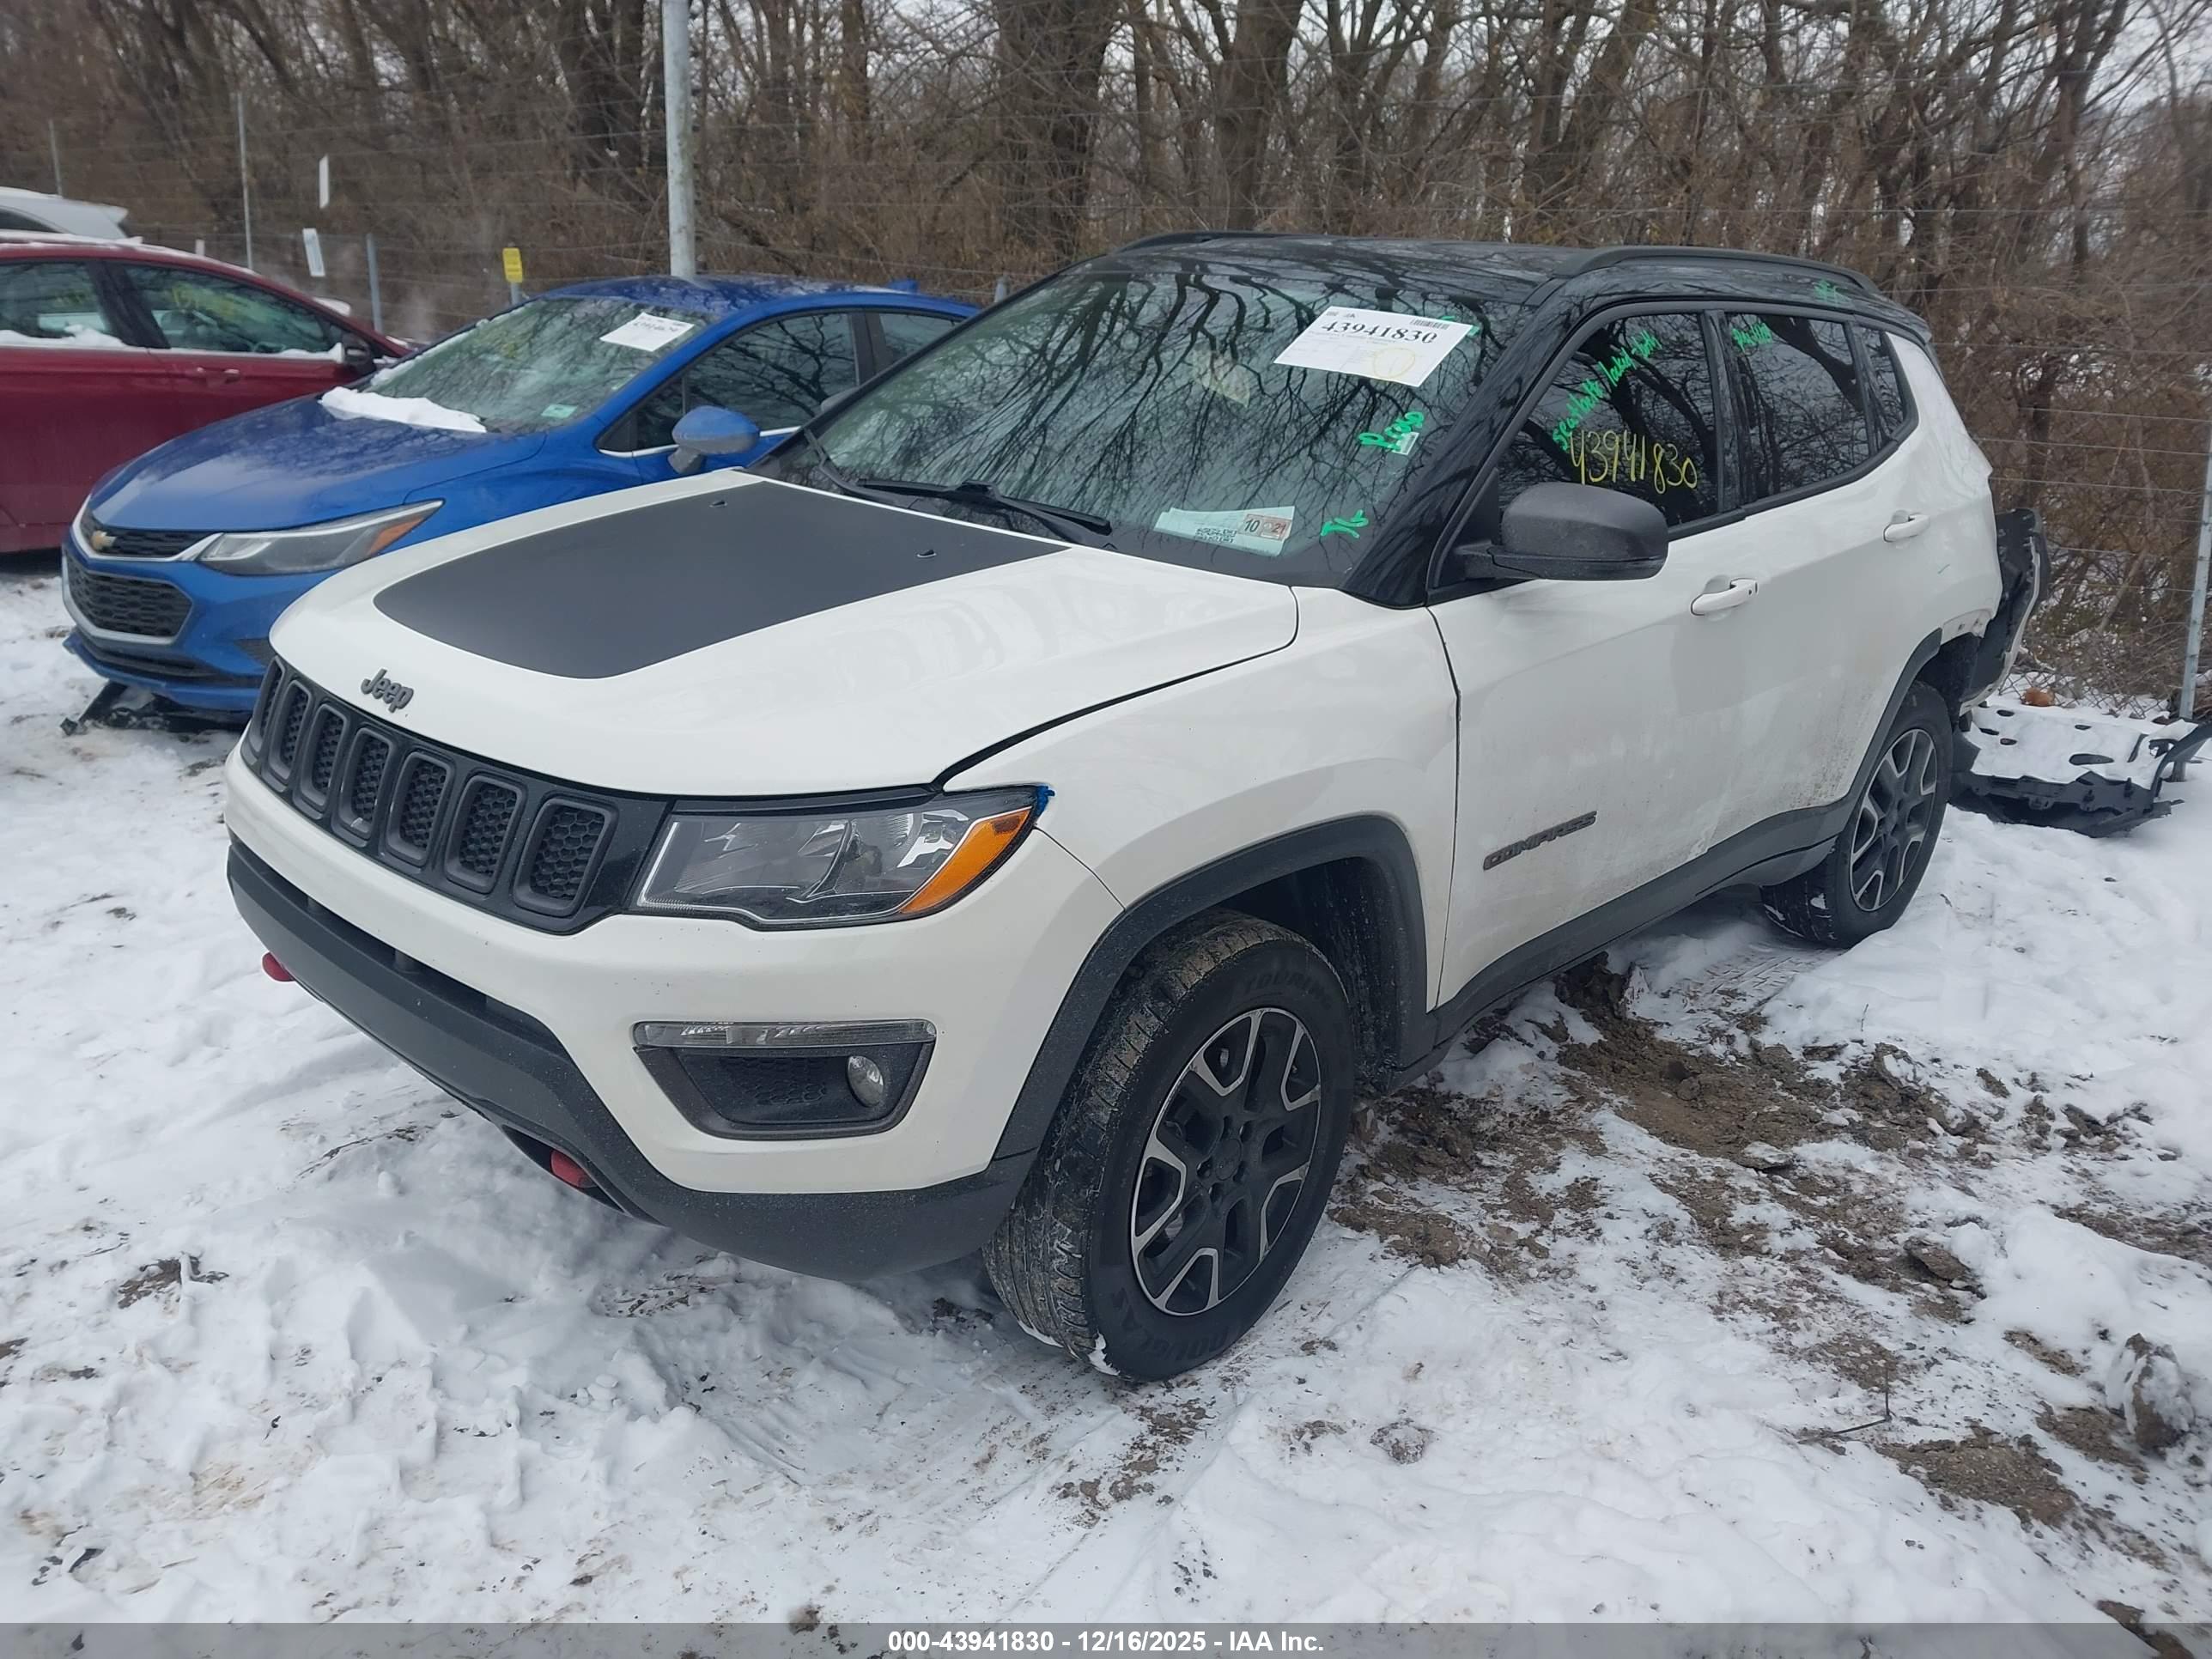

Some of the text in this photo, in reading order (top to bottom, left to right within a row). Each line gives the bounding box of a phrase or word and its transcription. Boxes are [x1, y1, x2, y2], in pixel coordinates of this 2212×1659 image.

[1321, 320, 1437, 344] 43941830
[1571, 429, 1697, 494] 43941830
[1244, 519, 1261, 533] 10
[1272, 523, 1287, 534] 21
[361, 668, 414, 713] Jeep
